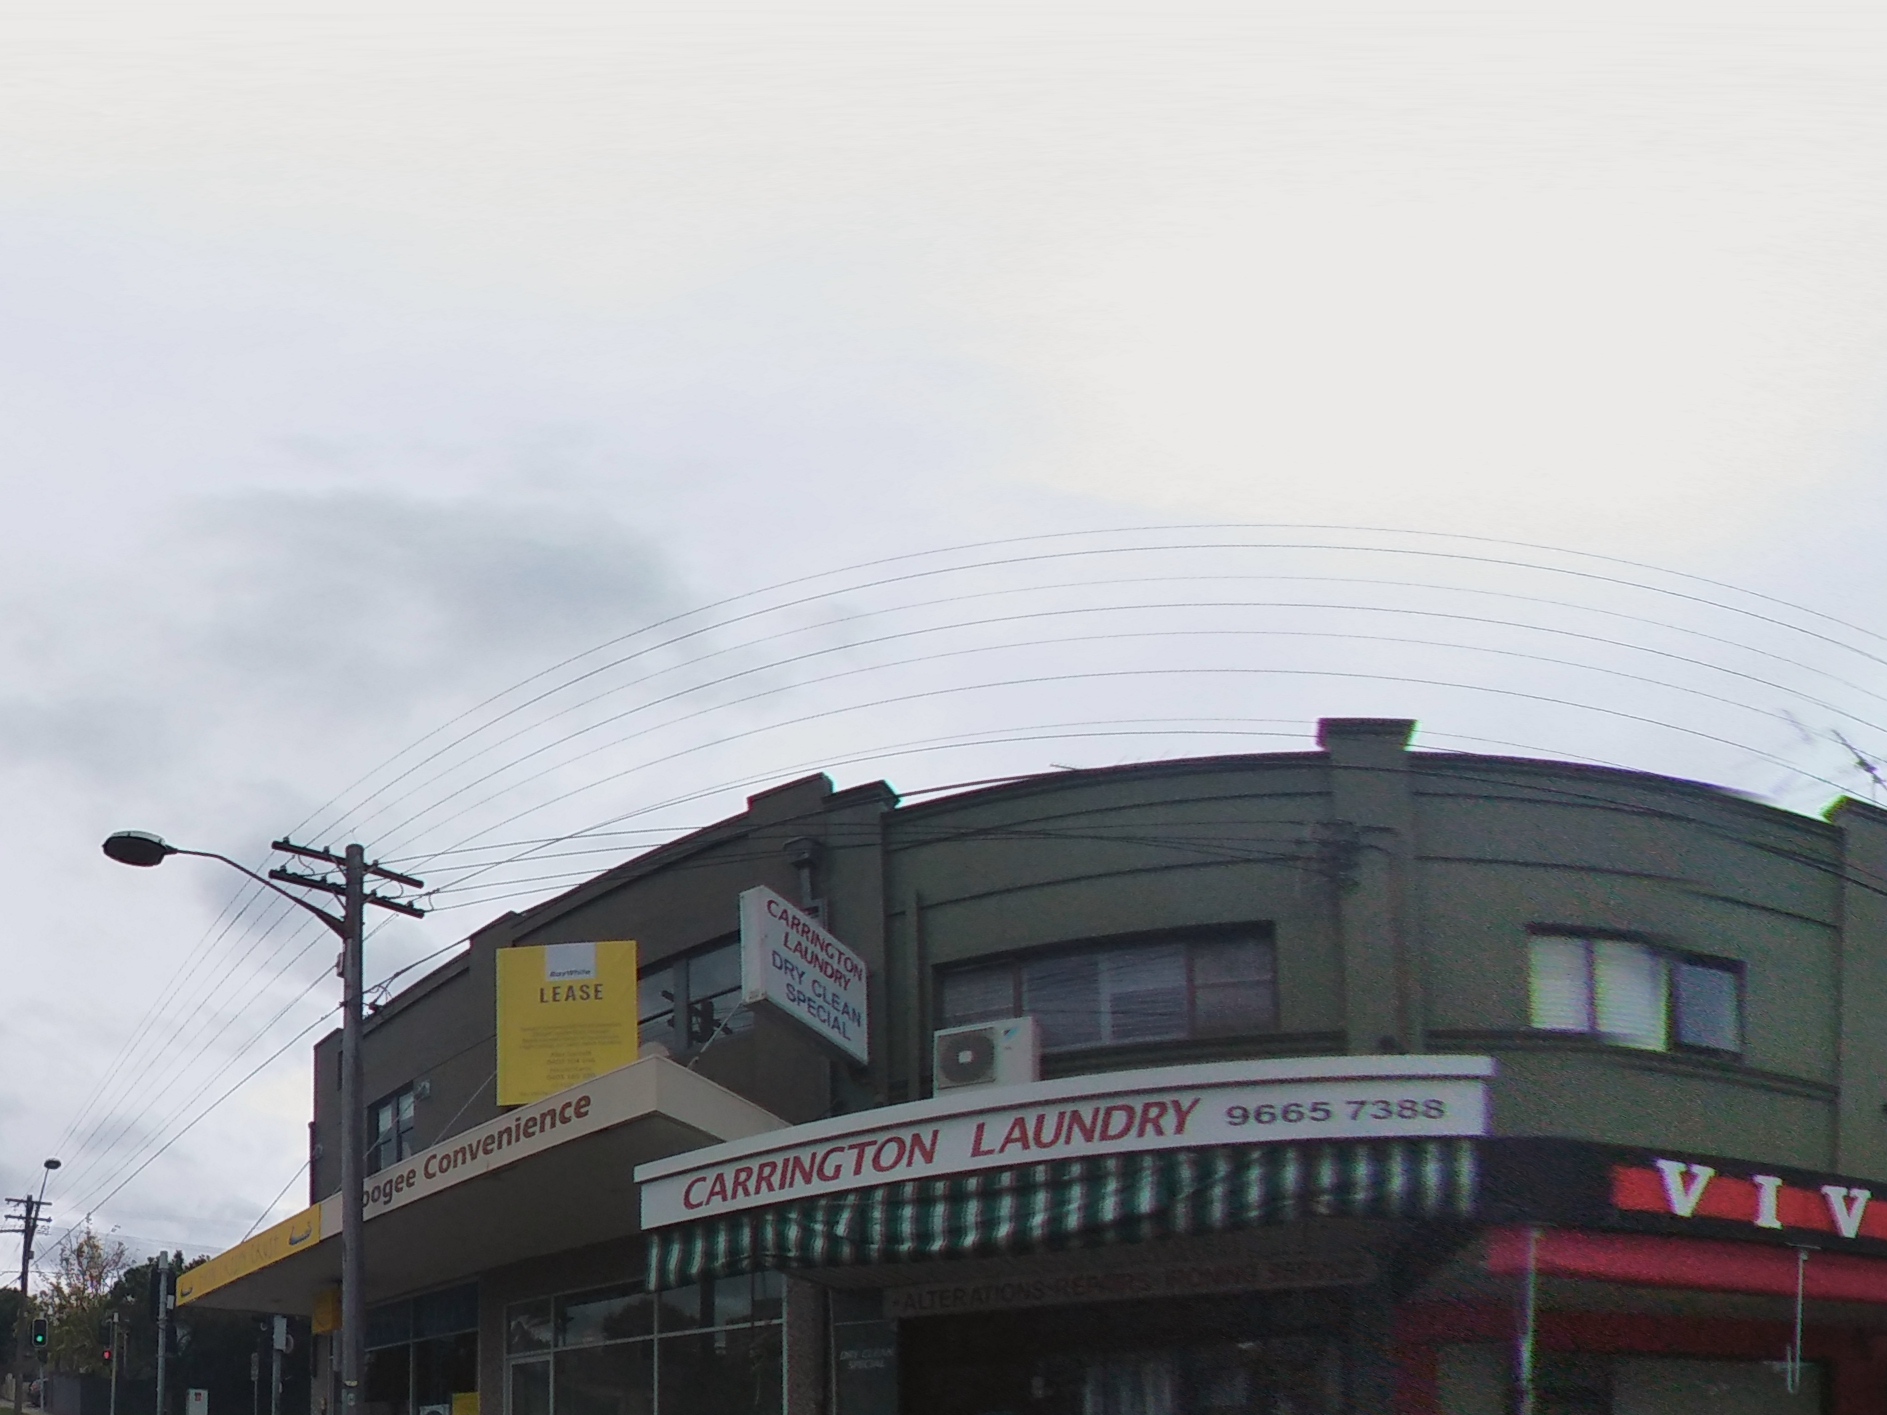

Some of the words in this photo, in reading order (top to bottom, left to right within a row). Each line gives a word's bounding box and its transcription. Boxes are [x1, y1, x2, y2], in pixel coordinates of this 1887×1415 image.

[767, 899, 863, 982] CARRINGTON
[783, 931, 851, 992] LAUNDRY
[539, 983, 604, 1004] LEASE
[771, 950, 806, 985] DRY
[811, 979, 862, 1027] CLEAN
[785, 983, 852, 1041] SPECIAL
[362, 1168, 417, 1209] oogee
[423, 1095, 592, 1180] Convenience
[682, 1128, 940, 1211] CARRINGTON
[970, 1097, 1201, 1158] LAUNDRY
[1225, 1101, 1332, 1126] 9665
[1345, 1099, 1446, 1120] 7388
